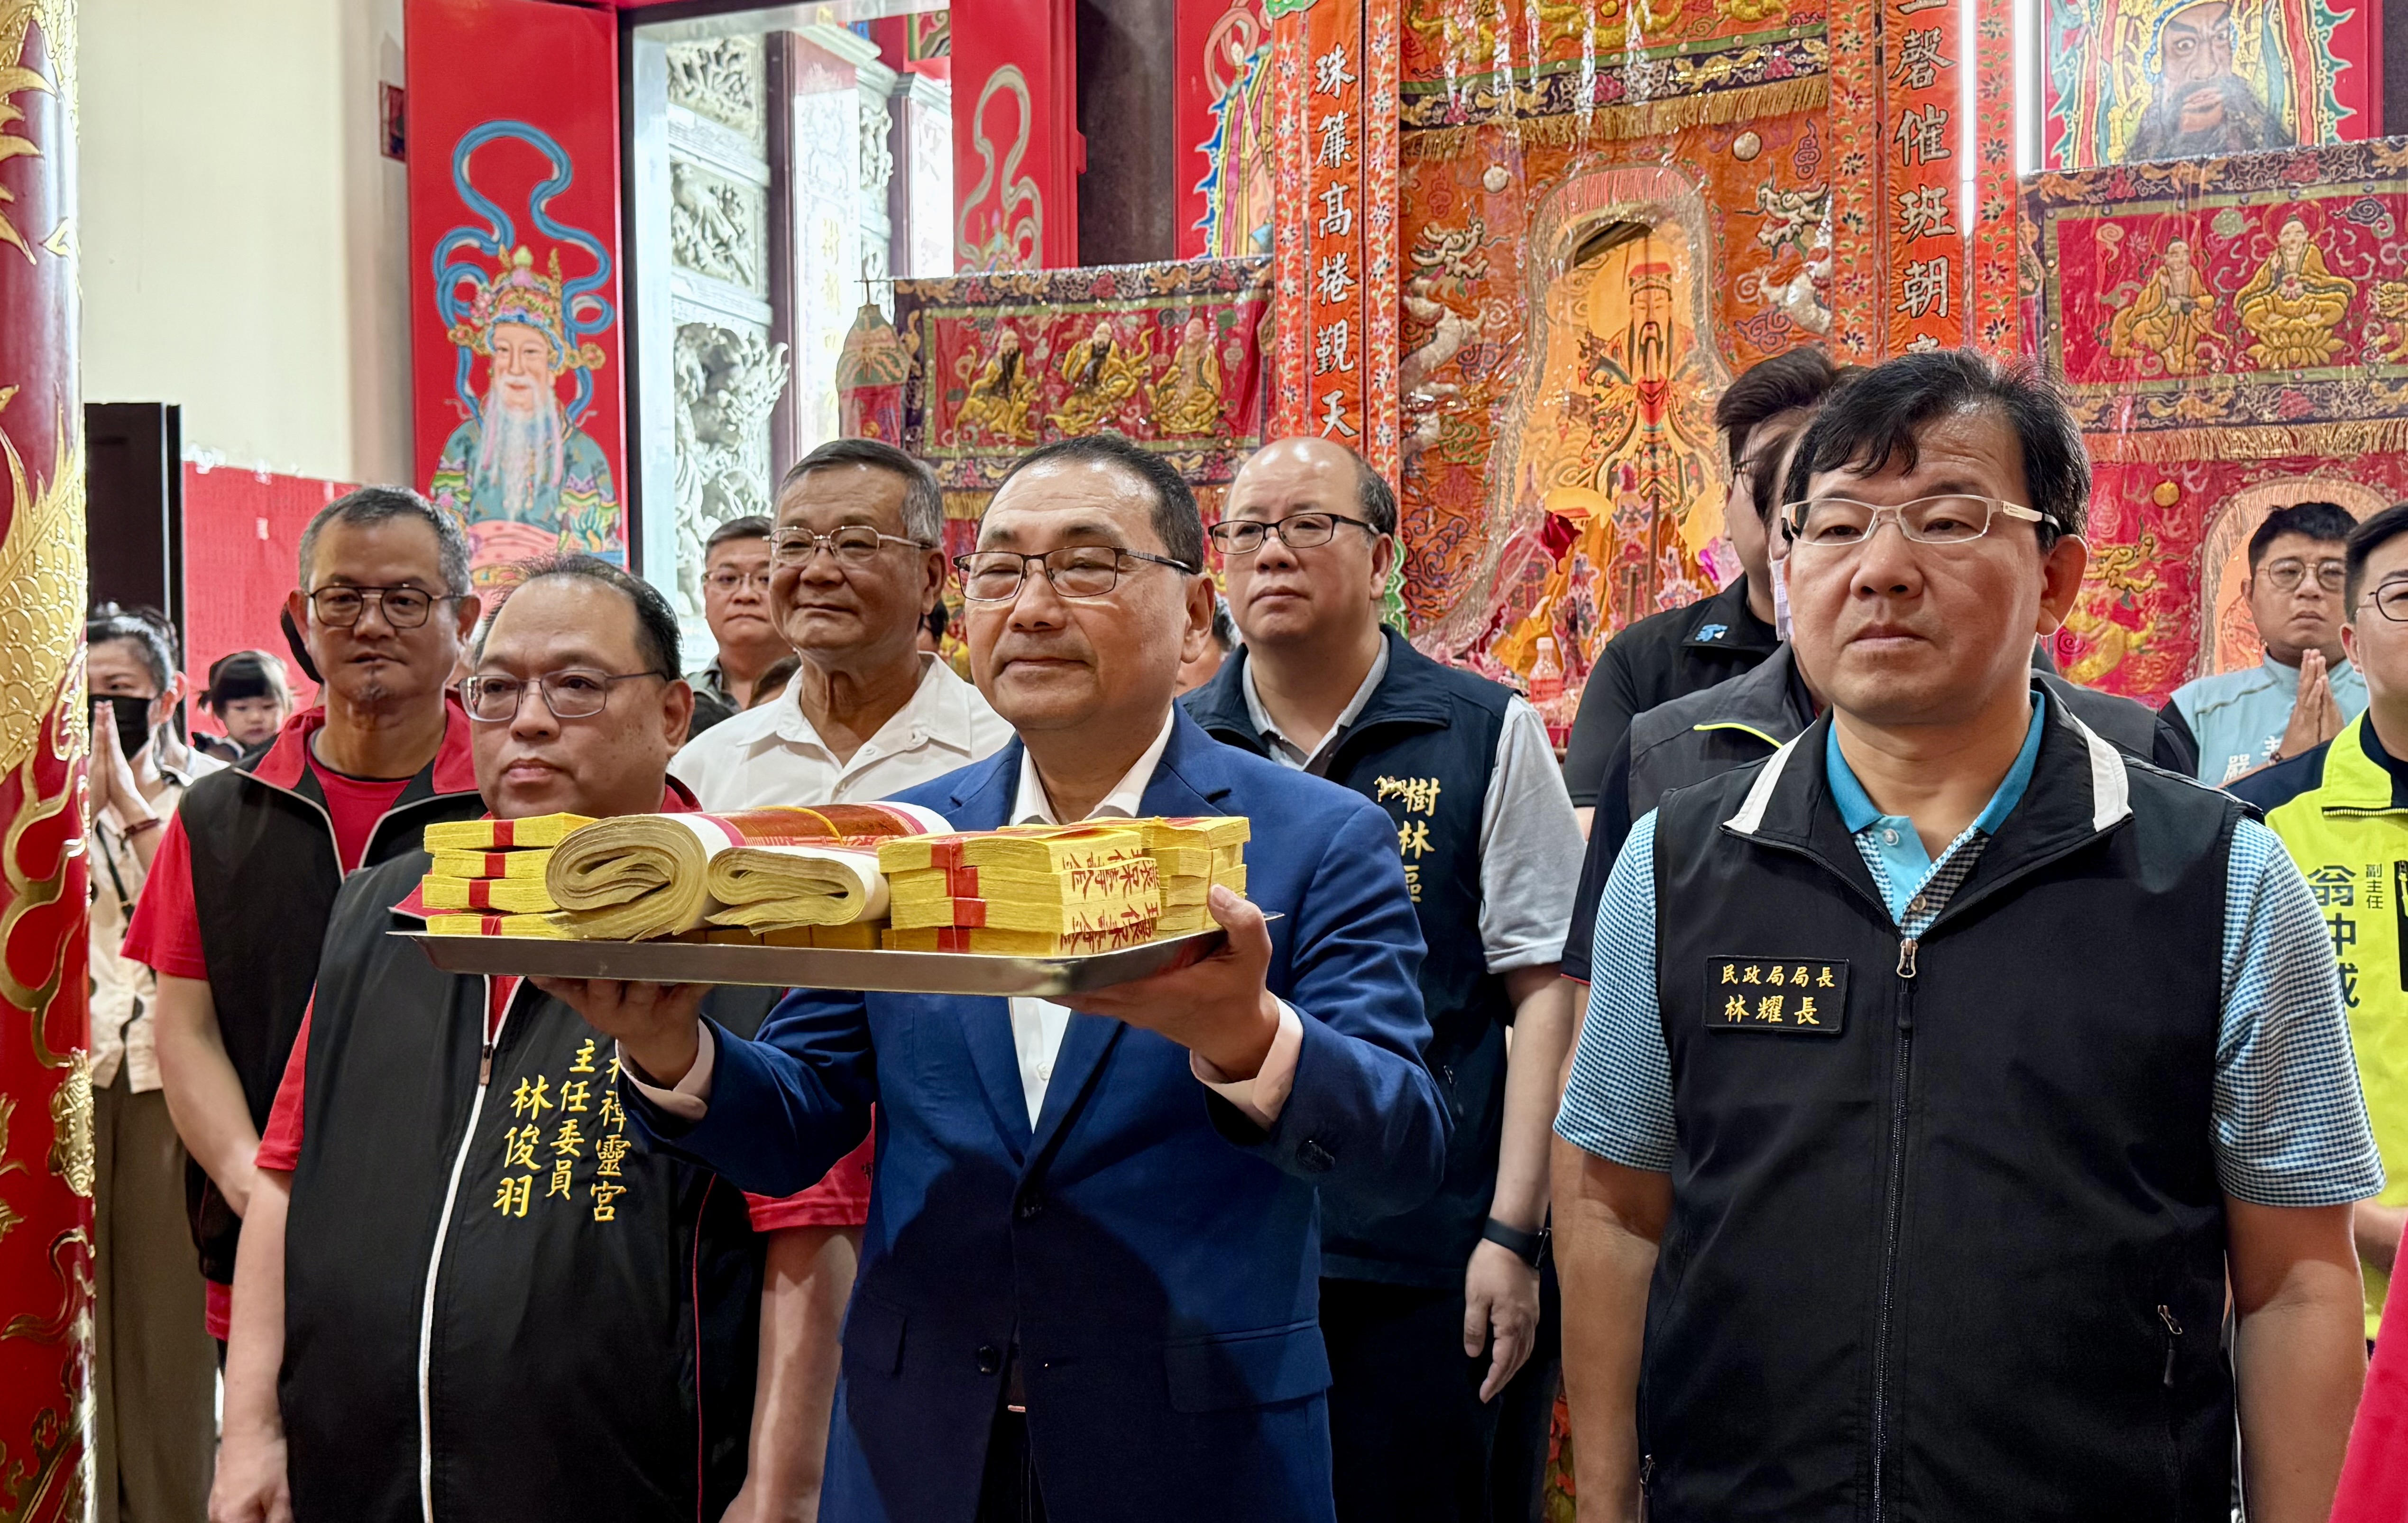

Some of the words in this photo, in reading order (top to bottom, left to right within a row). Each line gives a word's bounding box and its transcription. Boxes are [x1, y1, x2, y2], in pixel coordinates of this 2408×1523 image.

[1889, 0, 1957, 353] 磬催班朝
[2365, 863, 2383, 909] 副主任
[1721, 963, 1836, 988] 民政局局長
[1724, 994, 1820, 1025] 林耀長
[493, 1074, 554, 1218] 林俊羽
[545, 1038, 596, 1201] 主任委員
